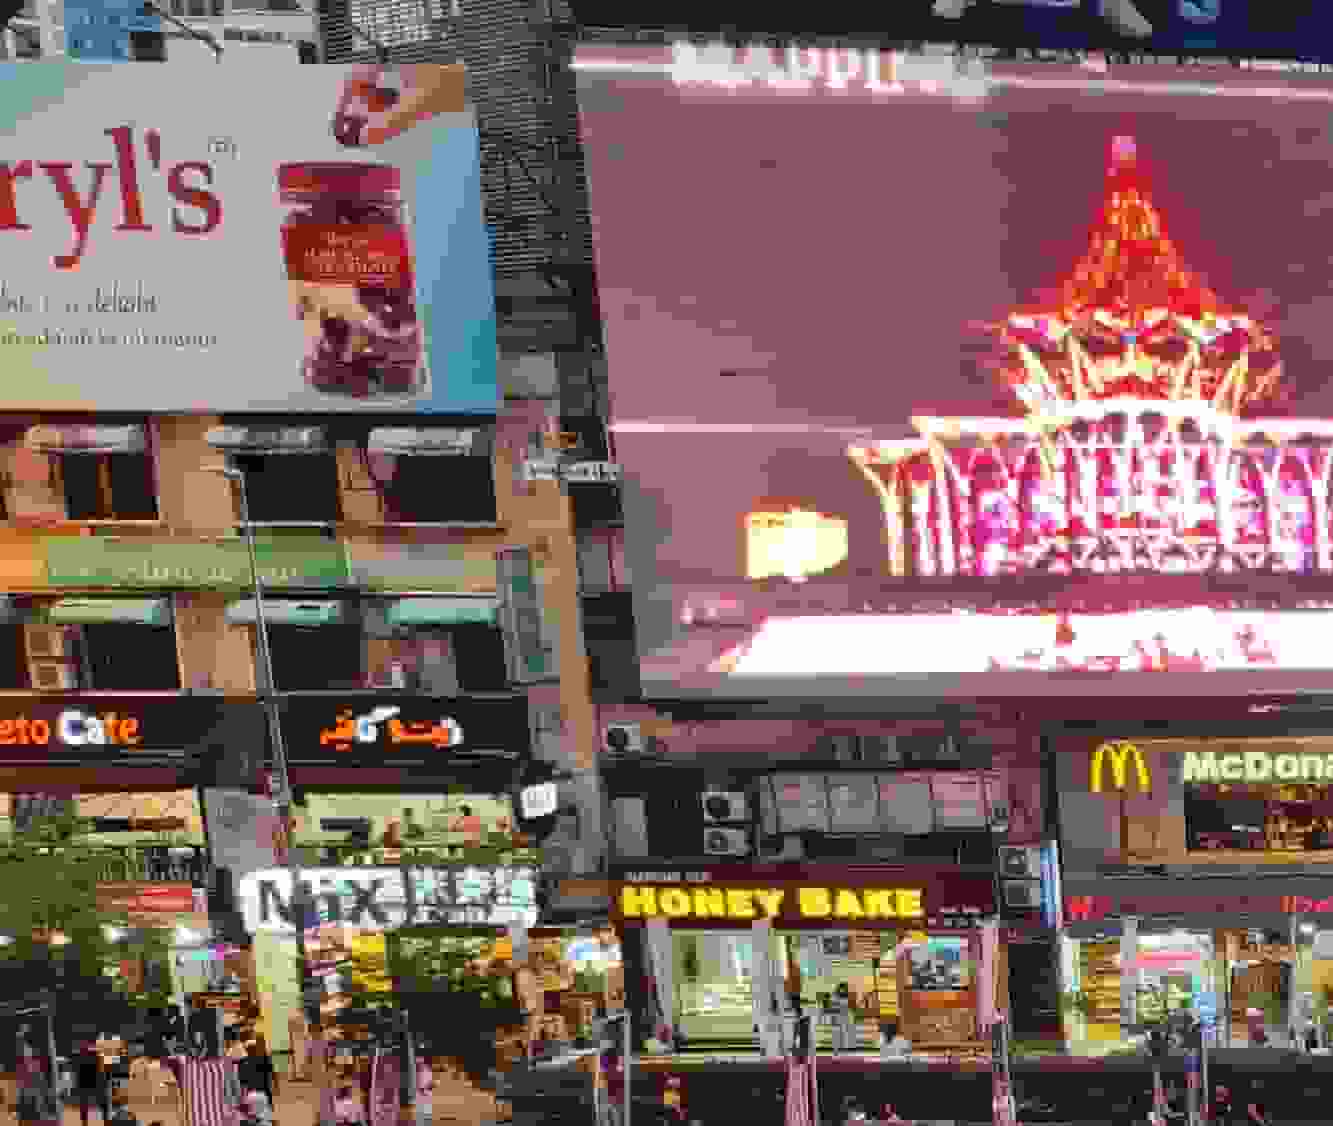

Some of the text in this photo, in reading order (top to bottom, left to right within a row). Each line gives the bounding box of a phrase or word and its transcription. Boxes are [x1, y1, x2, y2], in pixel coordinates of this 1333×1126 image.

[0, 126, 224, 270] ryl's
[619, 886, 923, 920] HONEY BAKE
